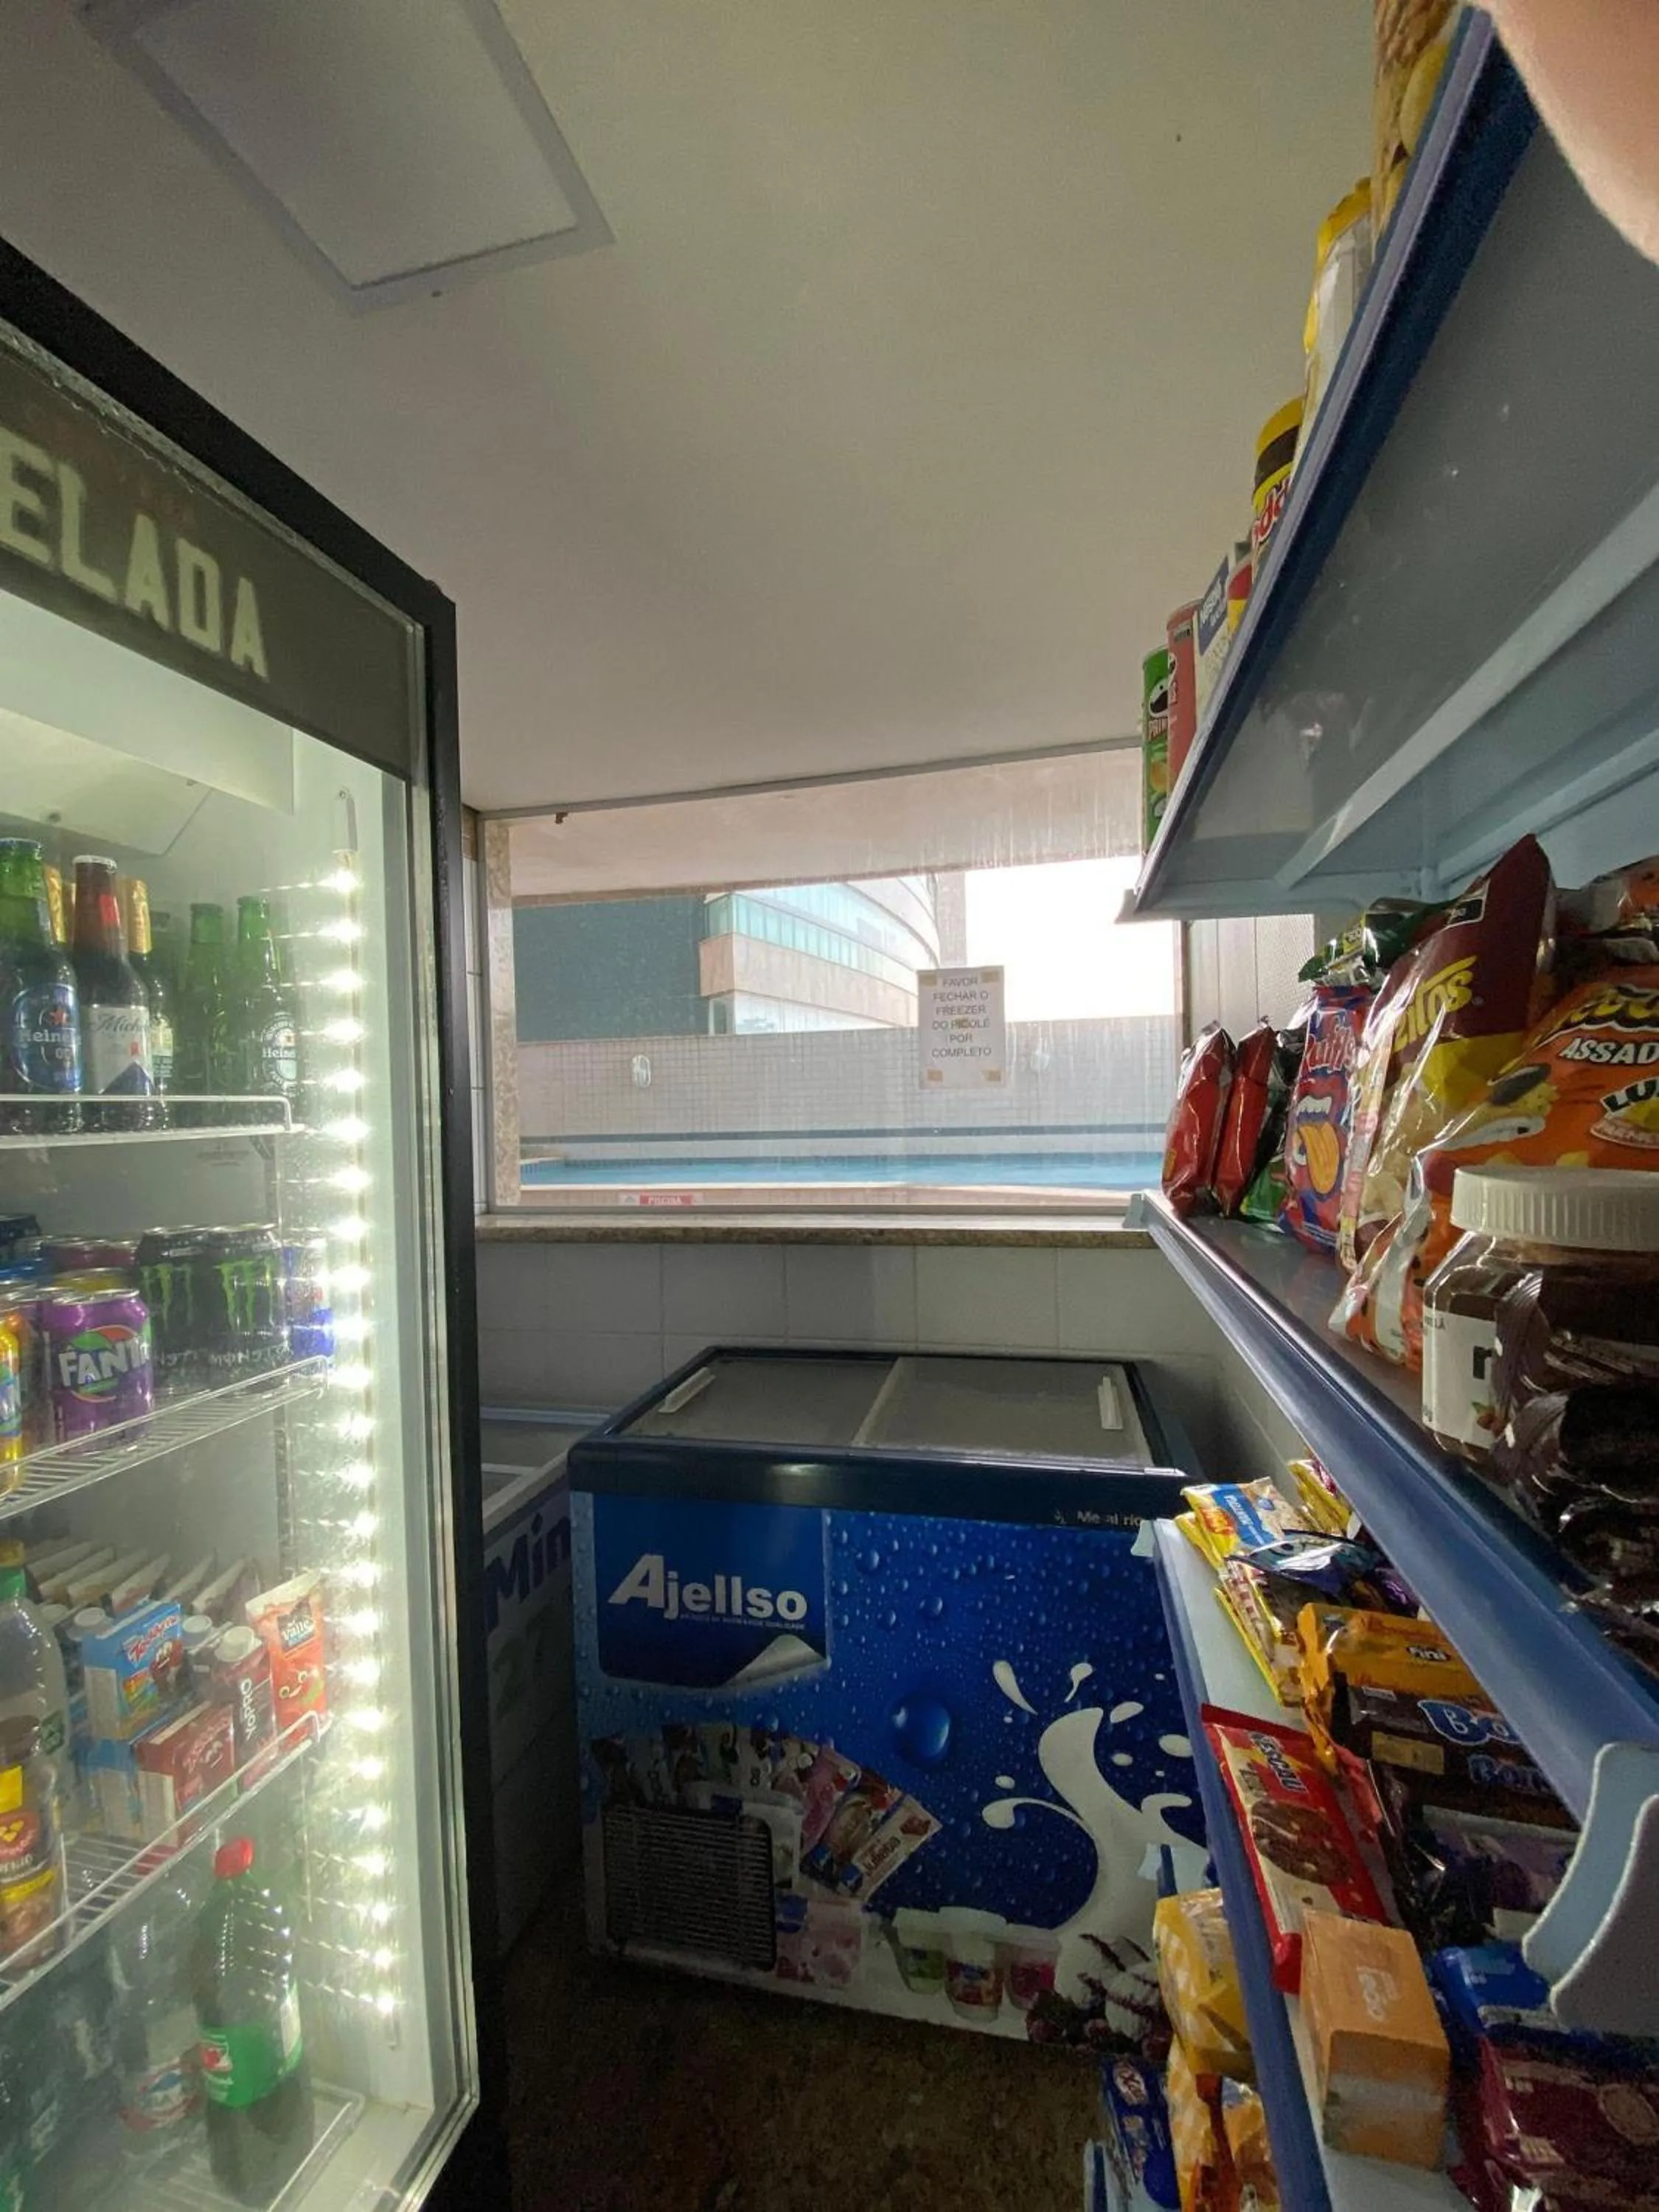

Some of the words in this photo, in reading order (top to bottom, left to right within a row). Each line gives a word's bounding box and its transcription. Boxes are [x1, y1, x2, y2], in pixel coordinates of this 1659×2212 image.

[942, 977, 978, 987] FAVOR
[933, 992, 977, 1002] FECHAR
[980, 991, 989, 1000] O
[936, 1005, 987, 1015] FREEZER
[932, 1020, 949, 1030] DO
[950, 1034, 973, 1043] POR
[931, 1047, 992, 1058] COMPLETO
[608, 1554, 809, 1621] Ajellso
